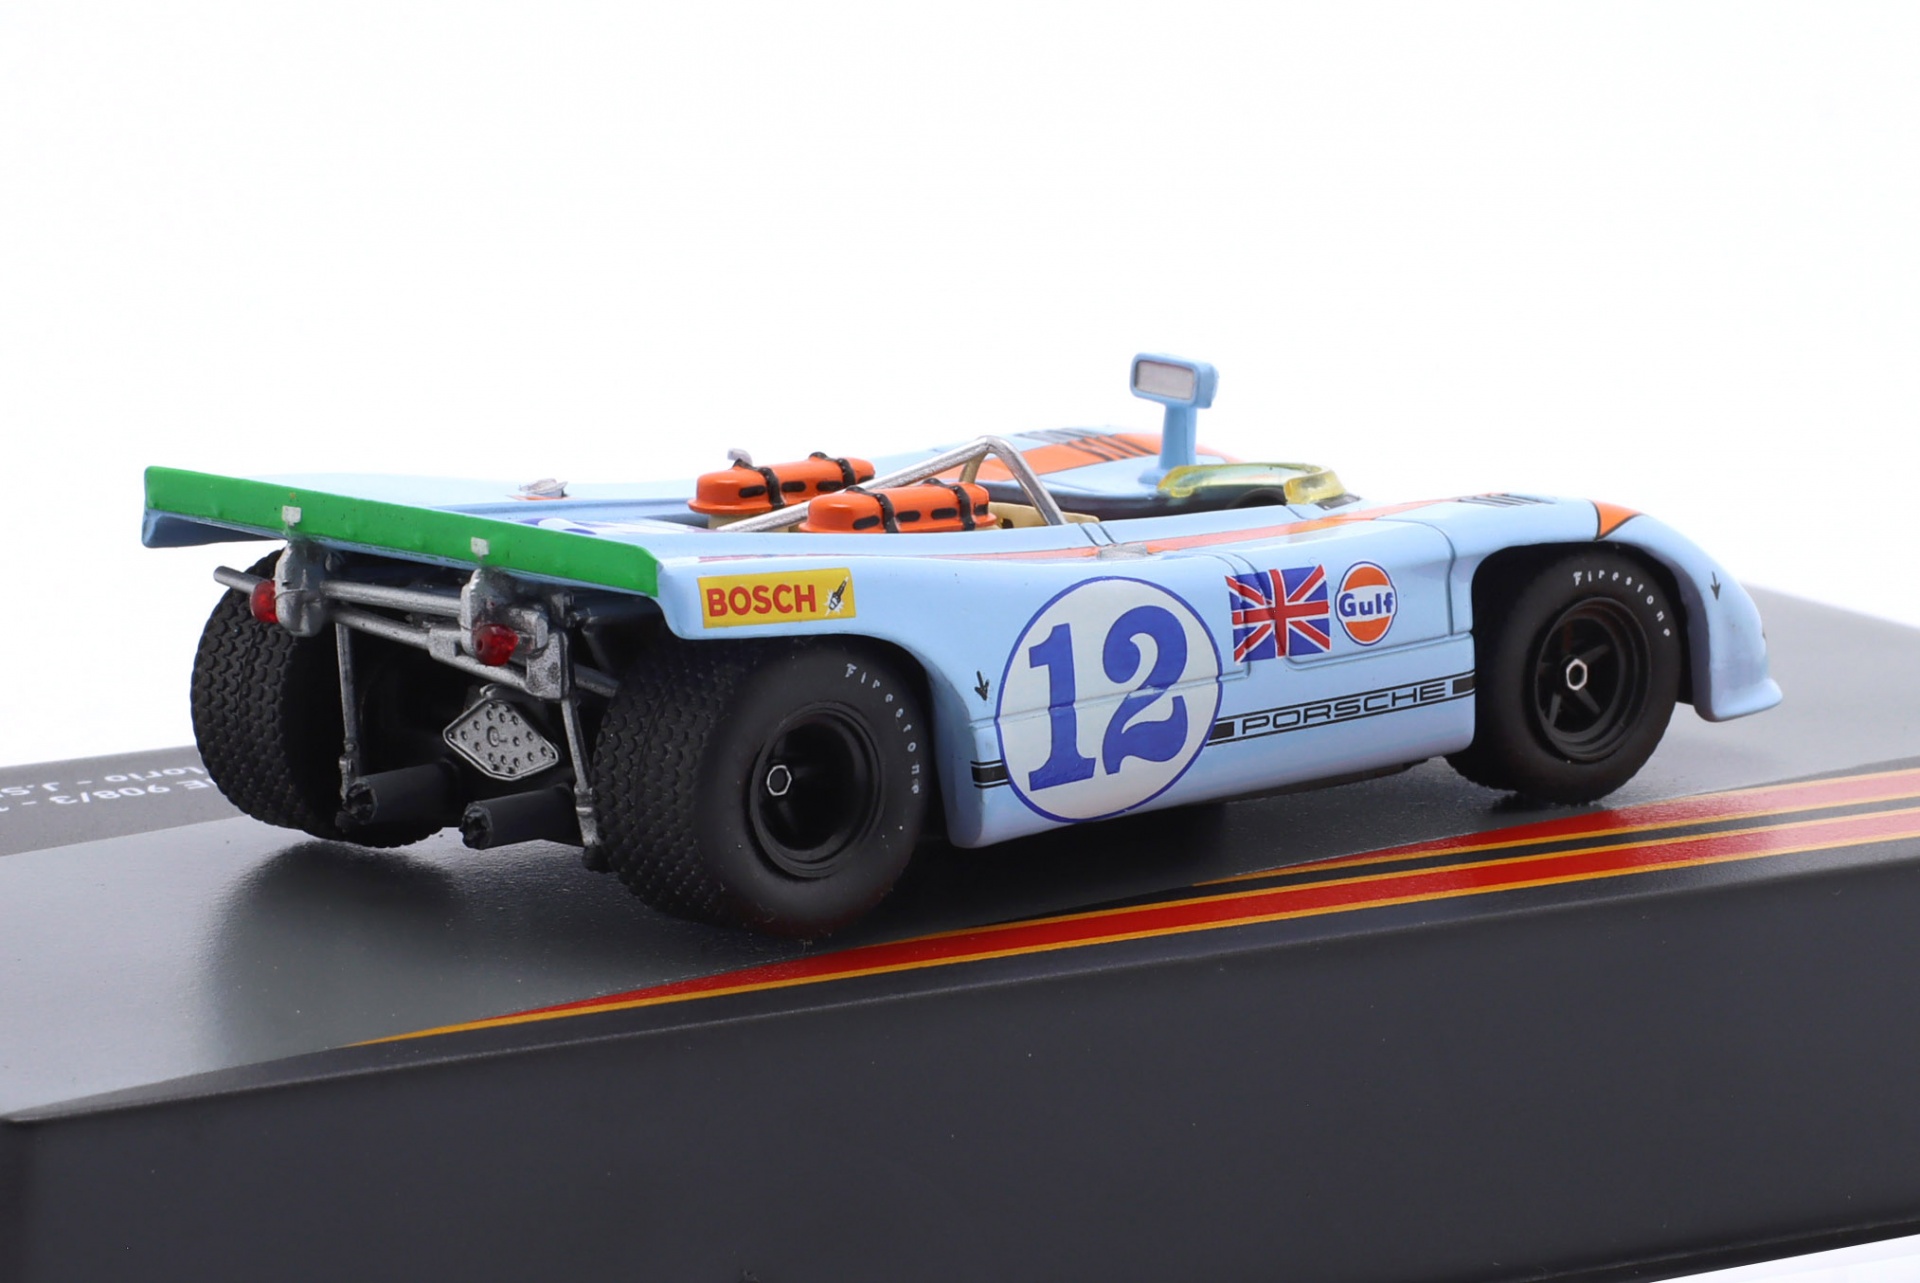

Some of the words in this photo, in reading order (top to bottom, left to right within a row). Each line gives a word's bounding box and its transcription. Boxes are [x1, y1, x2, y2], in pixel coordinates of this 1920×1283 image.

[706, 583, 817, 617] BOSCH
[1338, 591, 1394, 618] Gulf
[1573, 570, 1671, 637] Firestone
[1028, 605, 1188, 792] 12
[1241, 681, 1446, 735] PORSCHE
[845, 663, 920, 794] Firestone
[49, 784, 171, 805] 908/3
[105, 766, 205, 782] lorio
